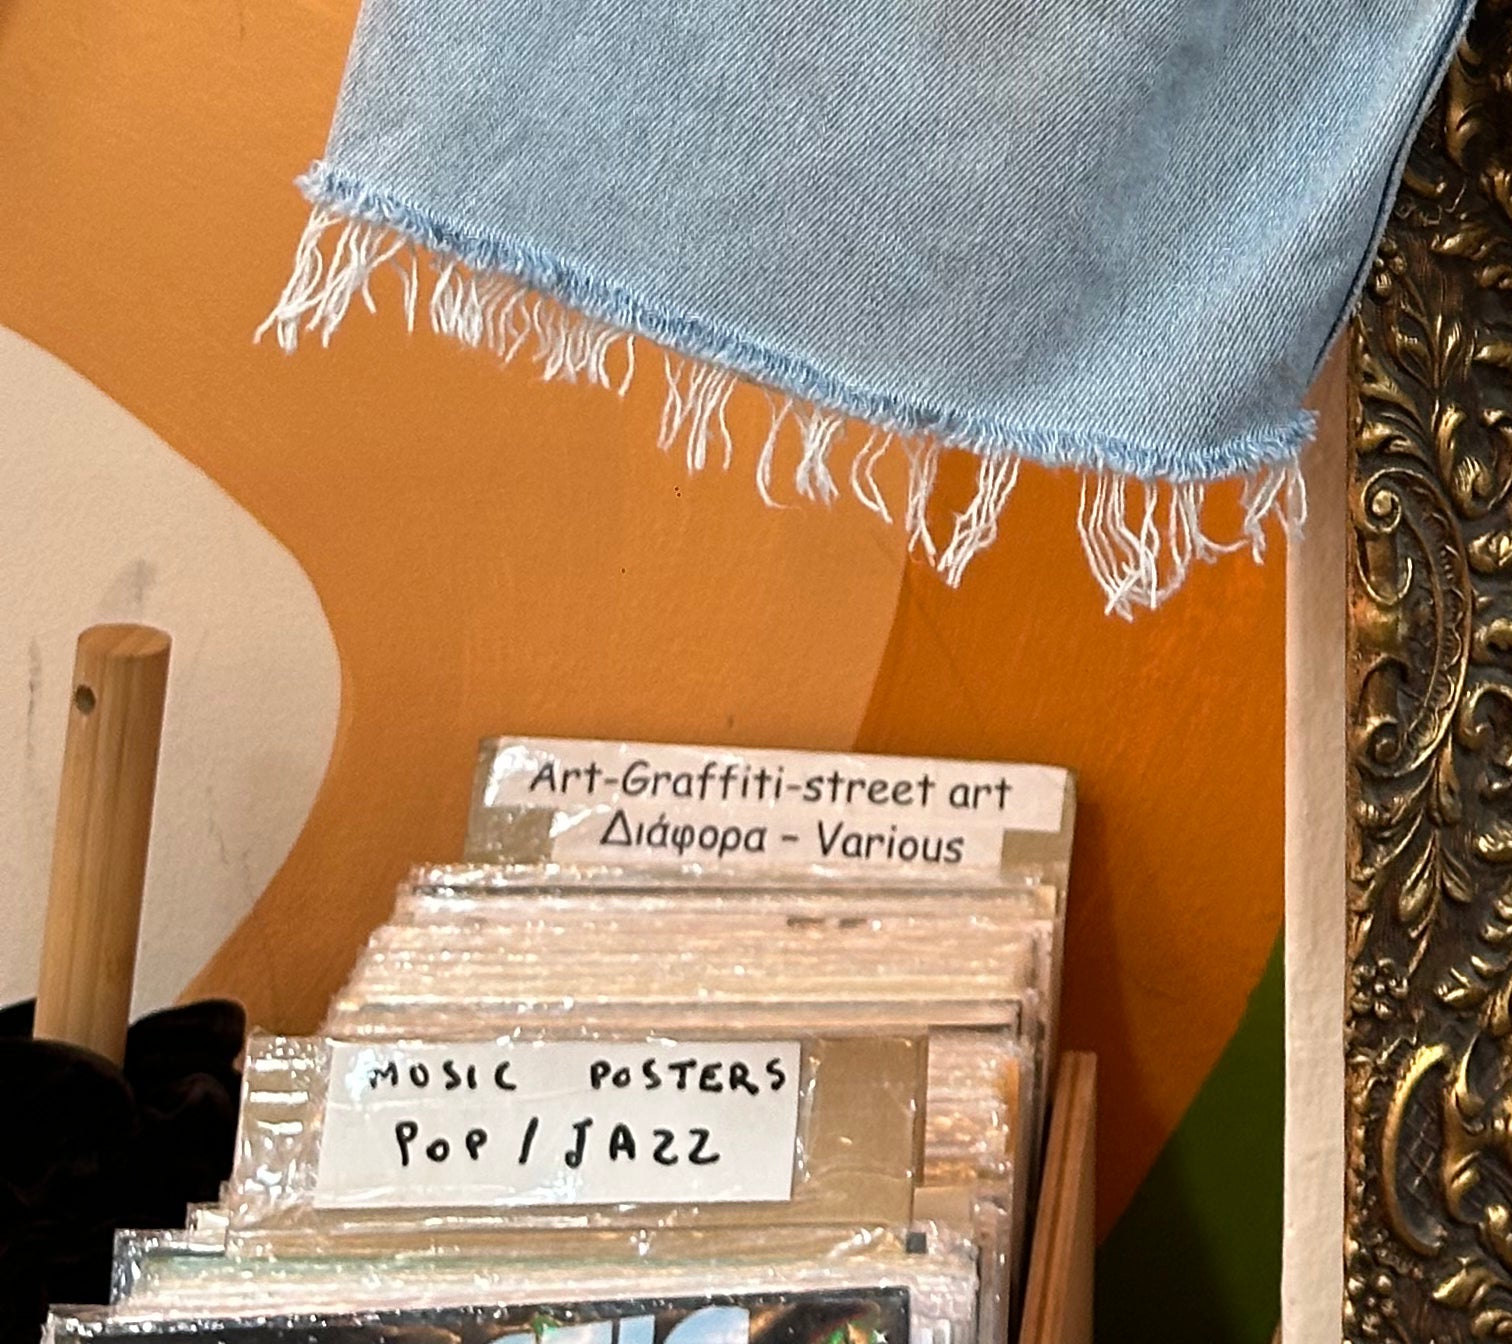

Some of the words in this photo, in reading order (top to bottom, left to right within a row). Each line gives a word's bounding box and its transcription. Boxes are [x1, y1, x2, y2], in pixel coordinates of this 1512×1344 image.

[528, 760, 936, 808] Art-Graffiti-street
[948, 777, 1014, 812] art
[599, 809, 767, 859] Διάφορα
[816, 820, 965, 864] Various
[590, 1058, 787, 1096] POSTERS
